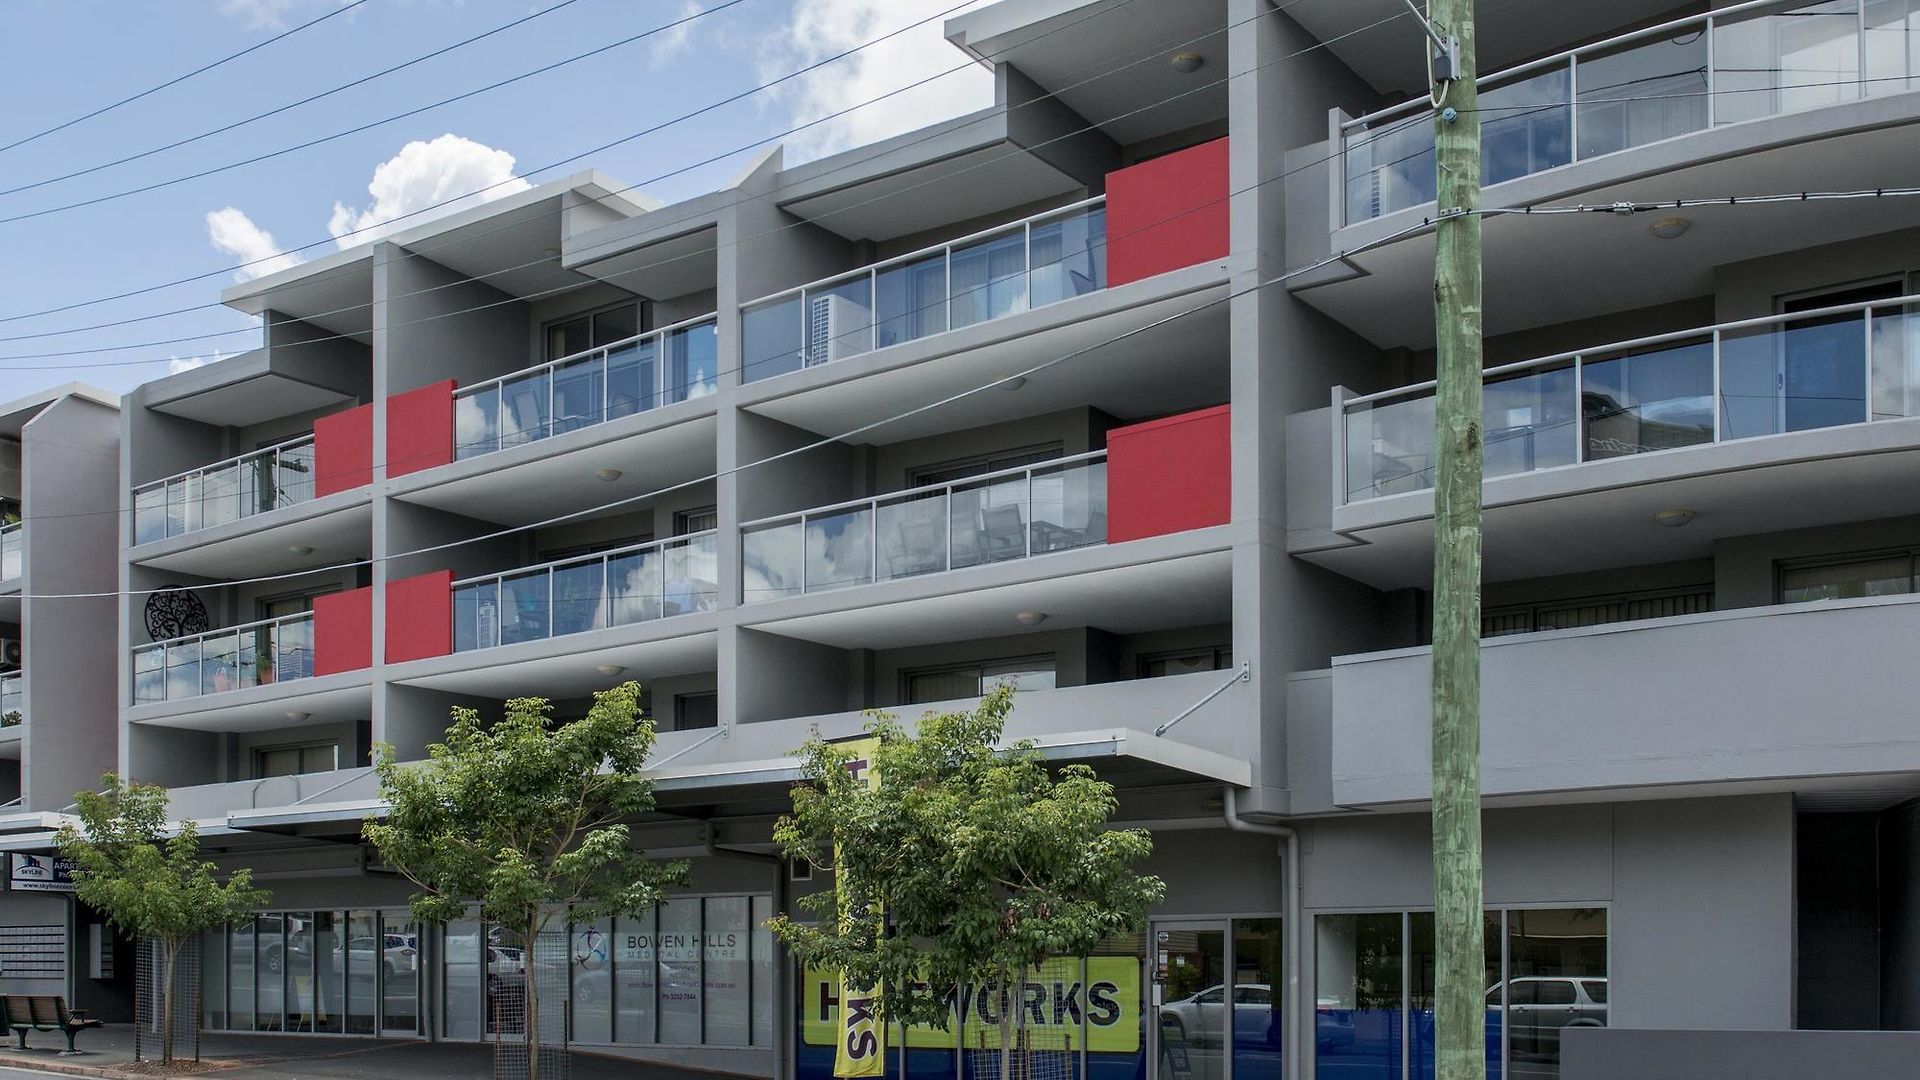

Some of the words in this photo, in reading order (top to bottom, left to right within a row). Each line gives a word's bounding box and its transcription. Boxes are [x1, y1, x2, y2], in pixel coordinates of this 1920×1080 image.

[628, 935, 684, 949] BOWEN
[692, 934, 736, 948] HILLS
[628, 950, 680, 959] MEDCAL
